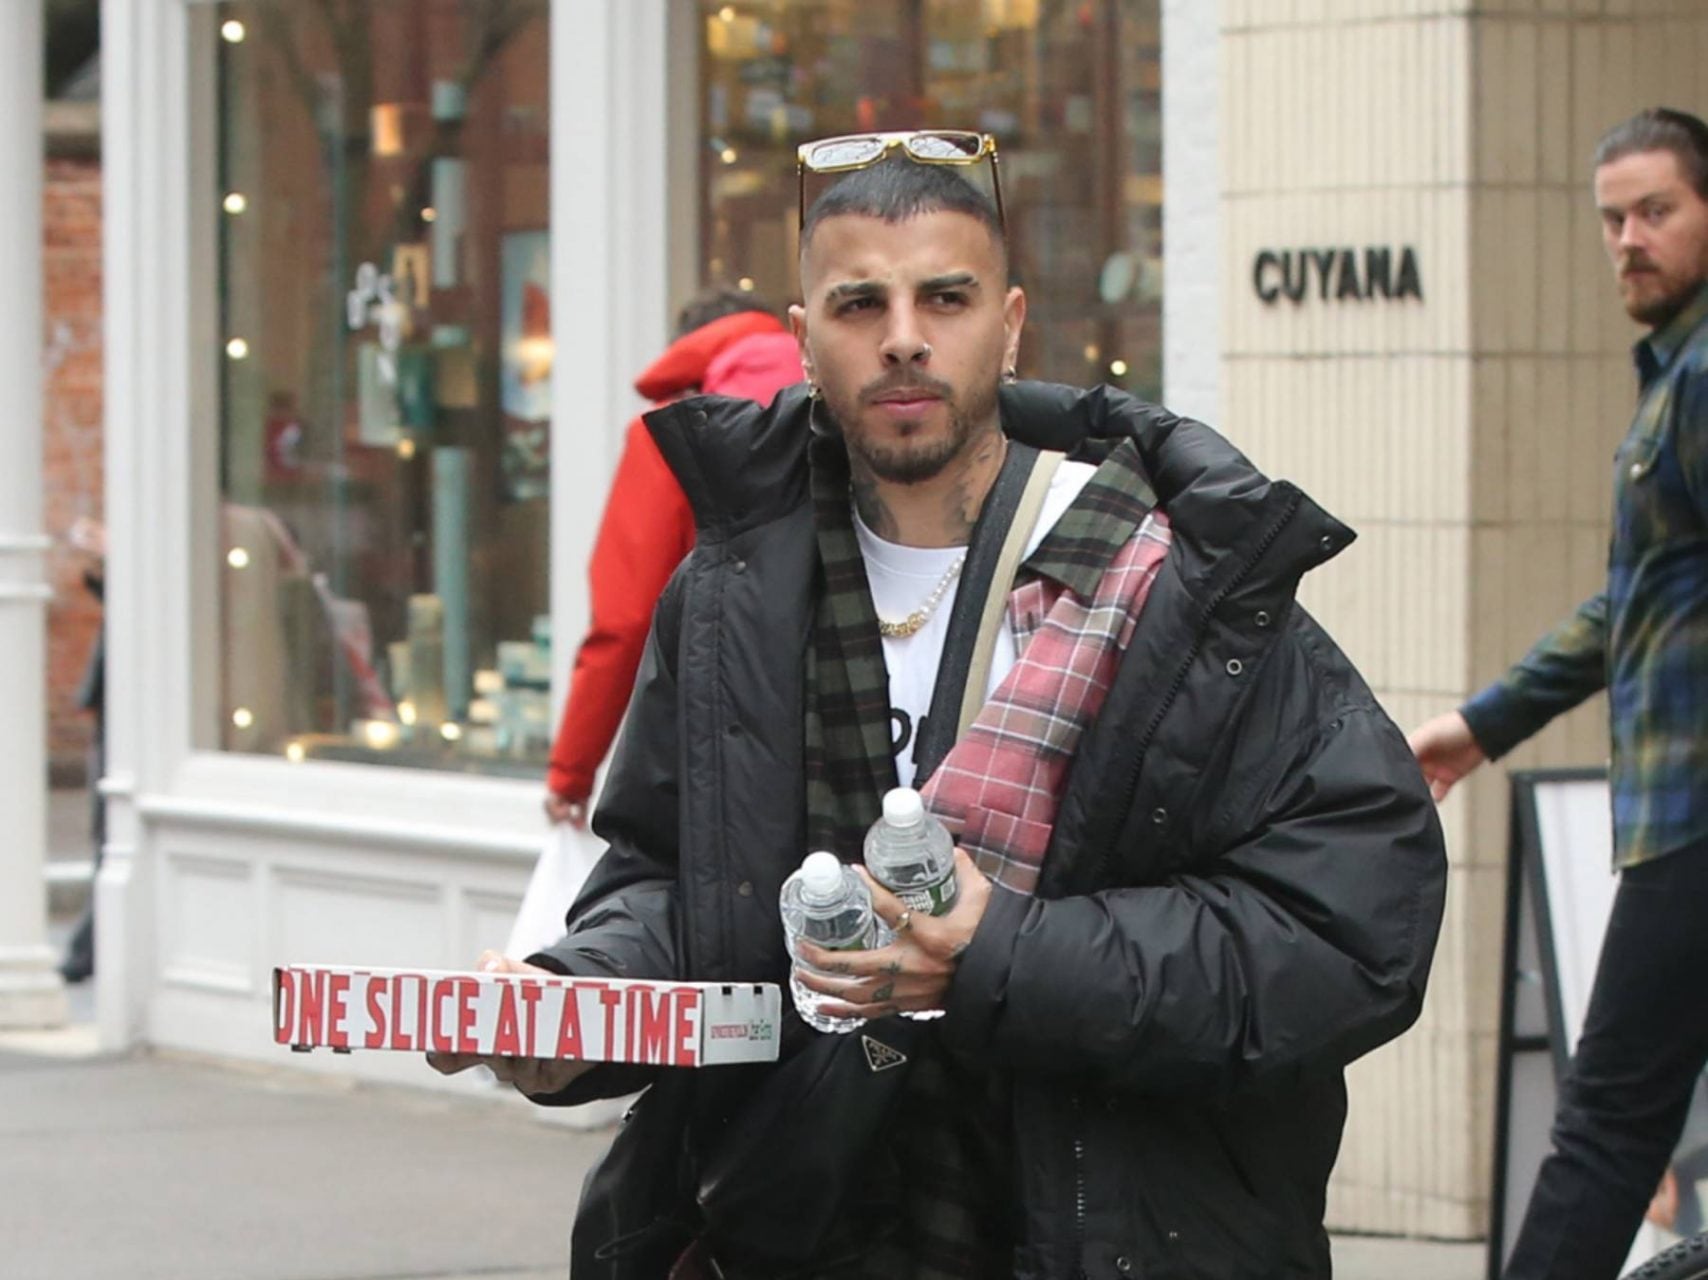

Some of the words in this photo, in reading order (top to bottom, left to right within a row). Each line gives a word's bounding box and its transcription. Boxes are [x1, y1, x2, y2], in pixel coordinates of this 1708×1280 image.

[1253, 247, 1425, 304] CUYANA
[277, 969, 350, 1048] ONE
[364, 975, 480, 1054] SLICE
[493, 984, 542, 1058] AT
[555, 988, 585, 1060] A
[600, 990, 697, 1068] TIME
